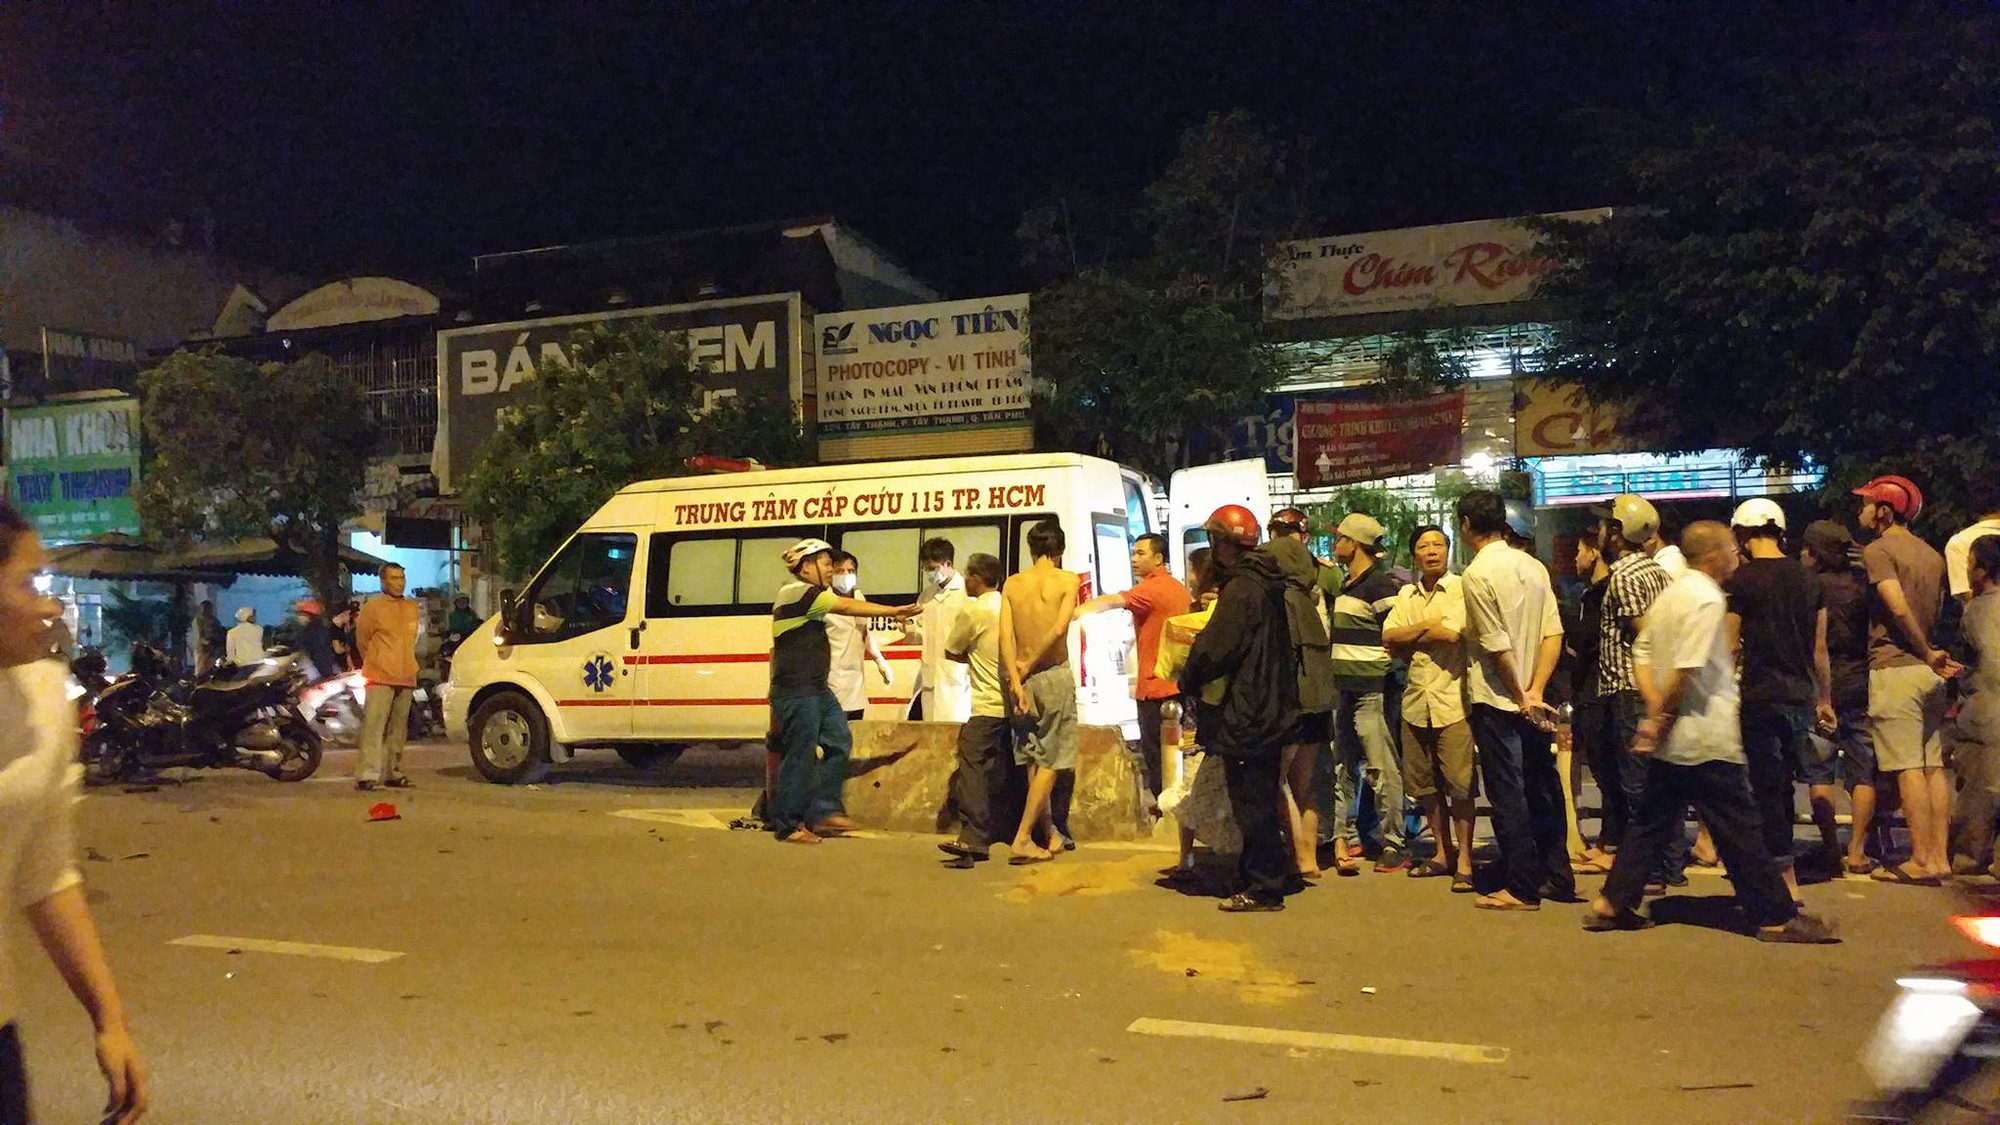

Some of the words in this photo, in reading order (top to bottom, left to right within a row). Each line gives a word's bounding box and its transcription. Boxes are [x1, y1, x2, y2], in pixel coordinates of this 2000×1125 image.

[867, 317, 940, 349] NGỌC
[951, 304, 1020, 337] TIÊN
[461, 331, 592, 397] BÁN
[677, 319, 778, 375] EM
[828, 357, 928, 383] PHOTOCOPY
[947, 353, 964, 372] VI
[674, 502, 745, 526] TRUNG
[752, 492, 797, 522] TÂM
[803, 486, 848, 519] CẤP
[853, 486, 903, 515] CỨU
[911, 491, 944, 514] 115
[951, 489, 982, 511] TP.
[989, 484, 1046, 509] HCM
